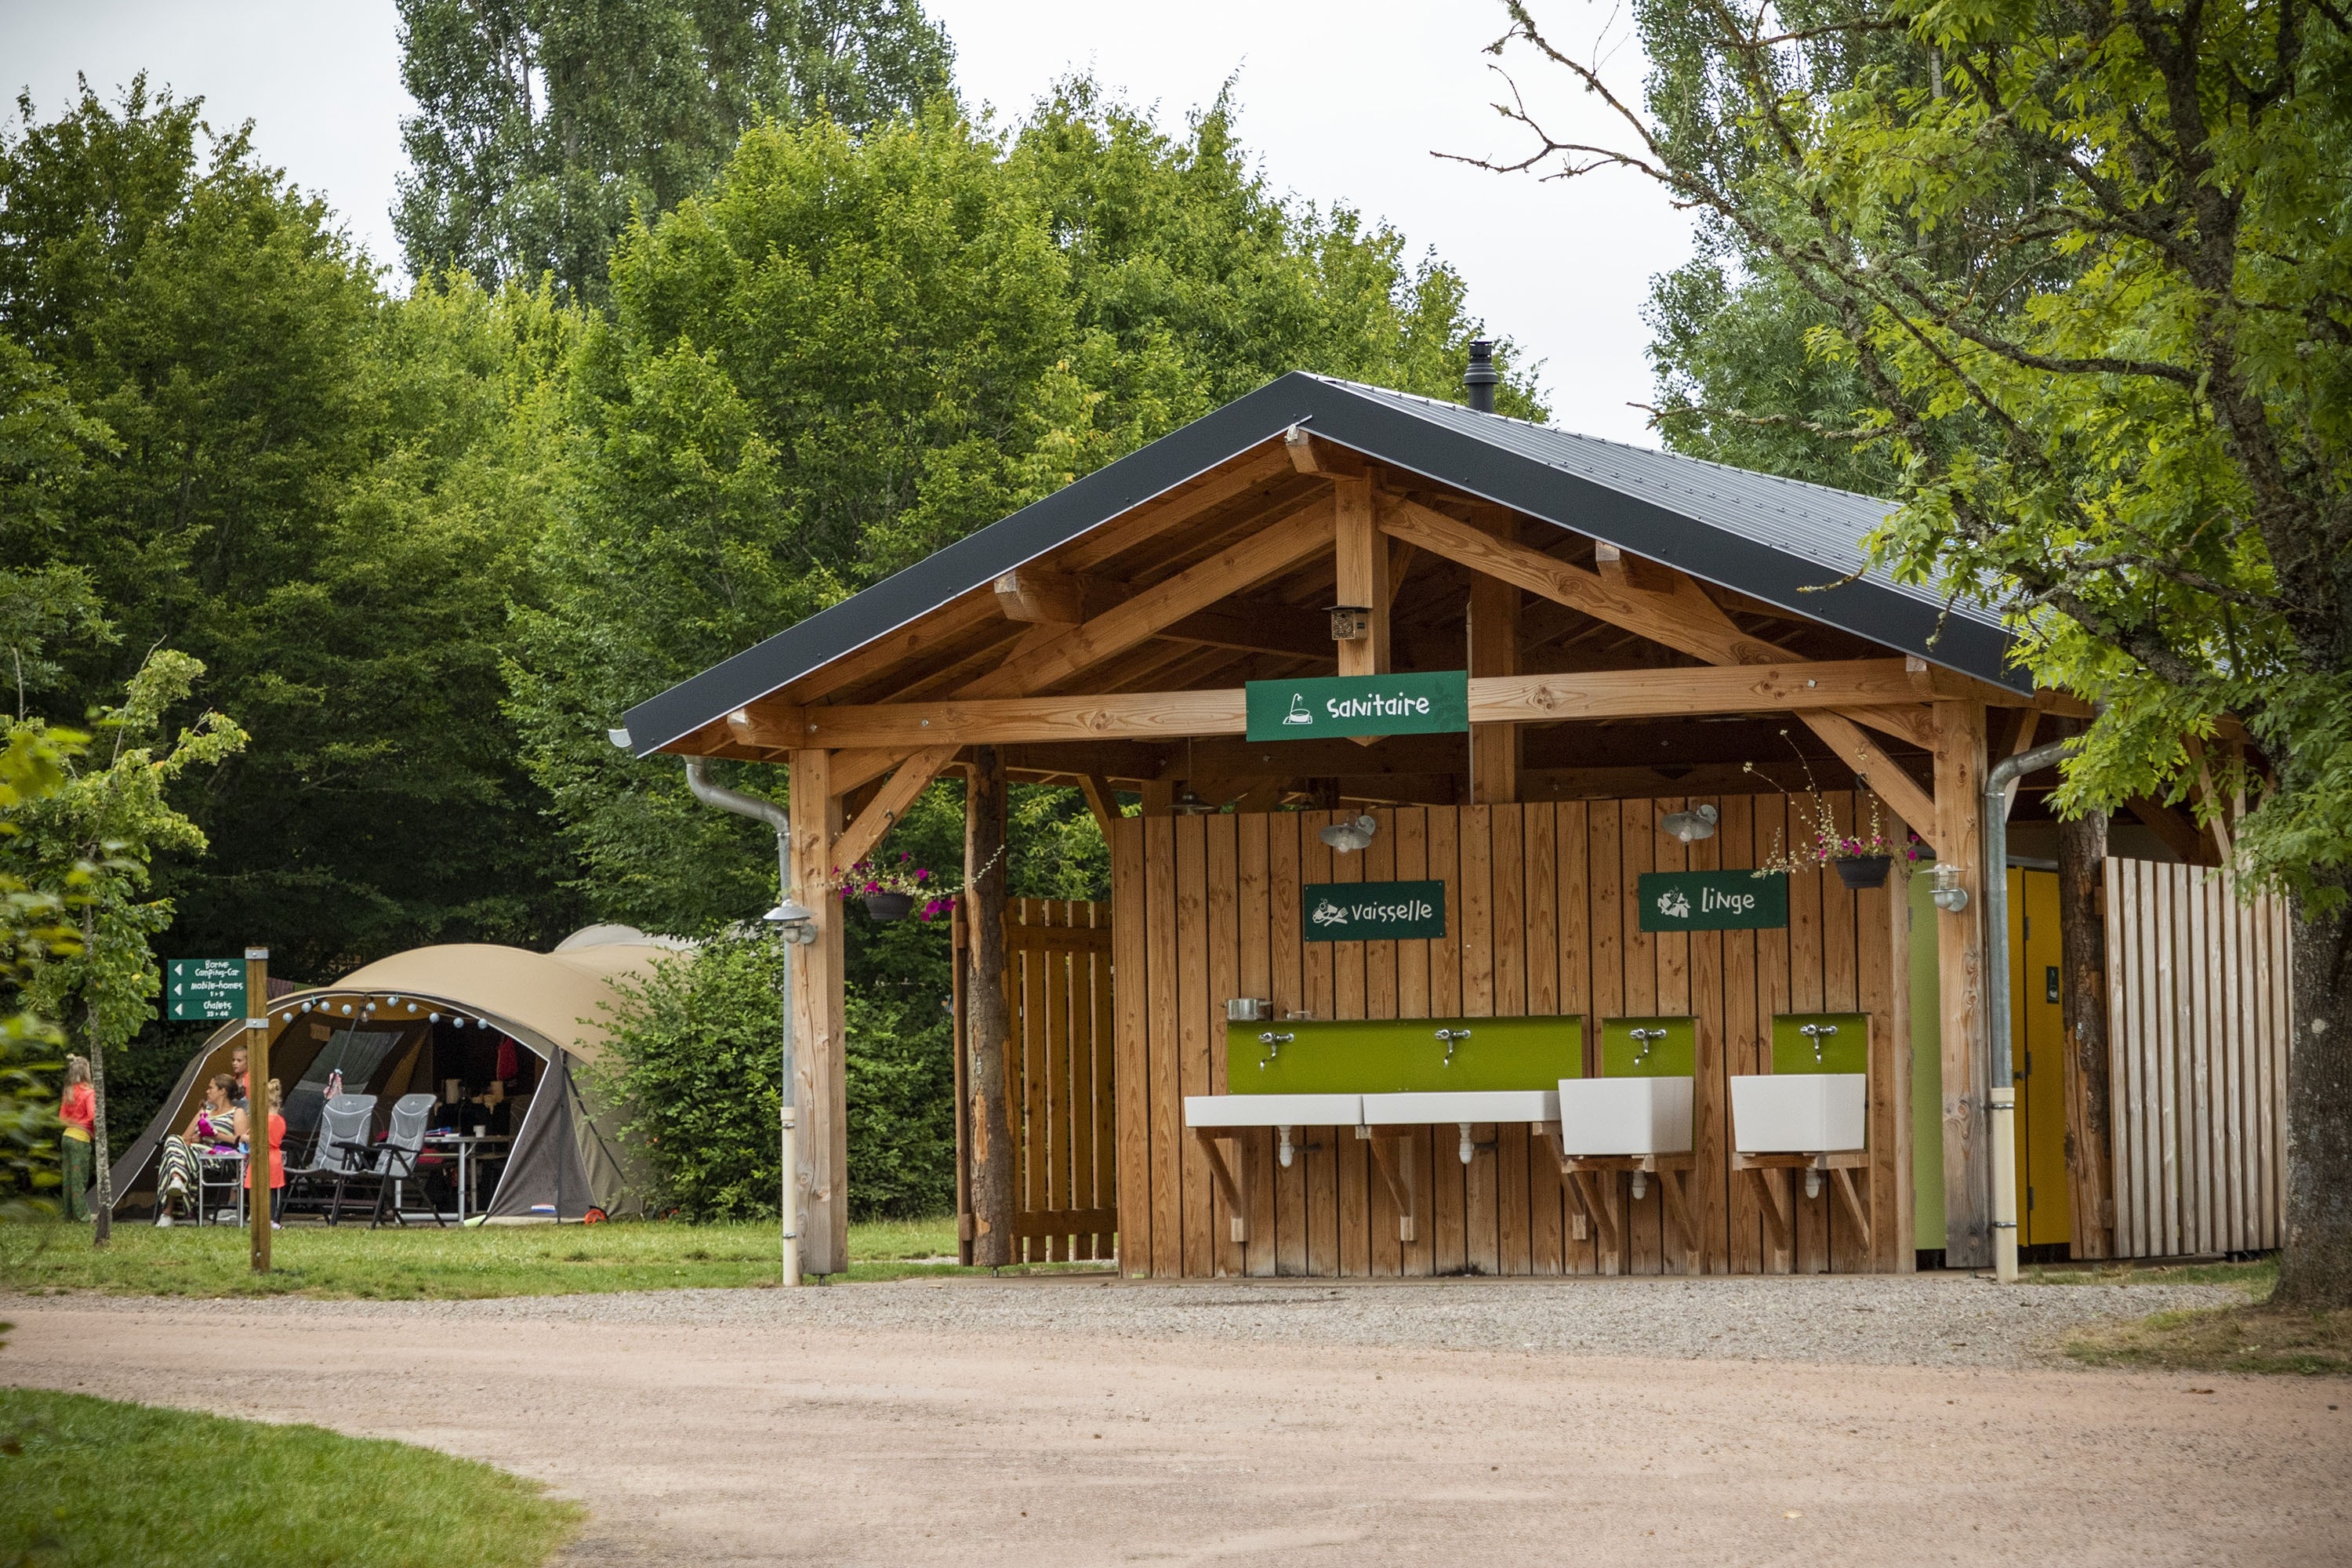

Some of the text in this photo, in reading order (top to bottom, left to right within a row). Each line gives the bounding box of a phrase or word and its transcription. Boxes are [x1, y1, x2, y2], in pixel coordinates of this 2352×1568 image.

[1327, 691, 1430, 719] Sanitaire
[1702, 887, 1755, 915] Linge
[1352, 900, 1432, 923] Vaisselle
[205, 960, 229, 969] Borne
[194, 967, 240, 978] Camping-Car
[191, 980, 243, 990] Mobile-homes
[203, 1000, 232, 1011] Chalets
